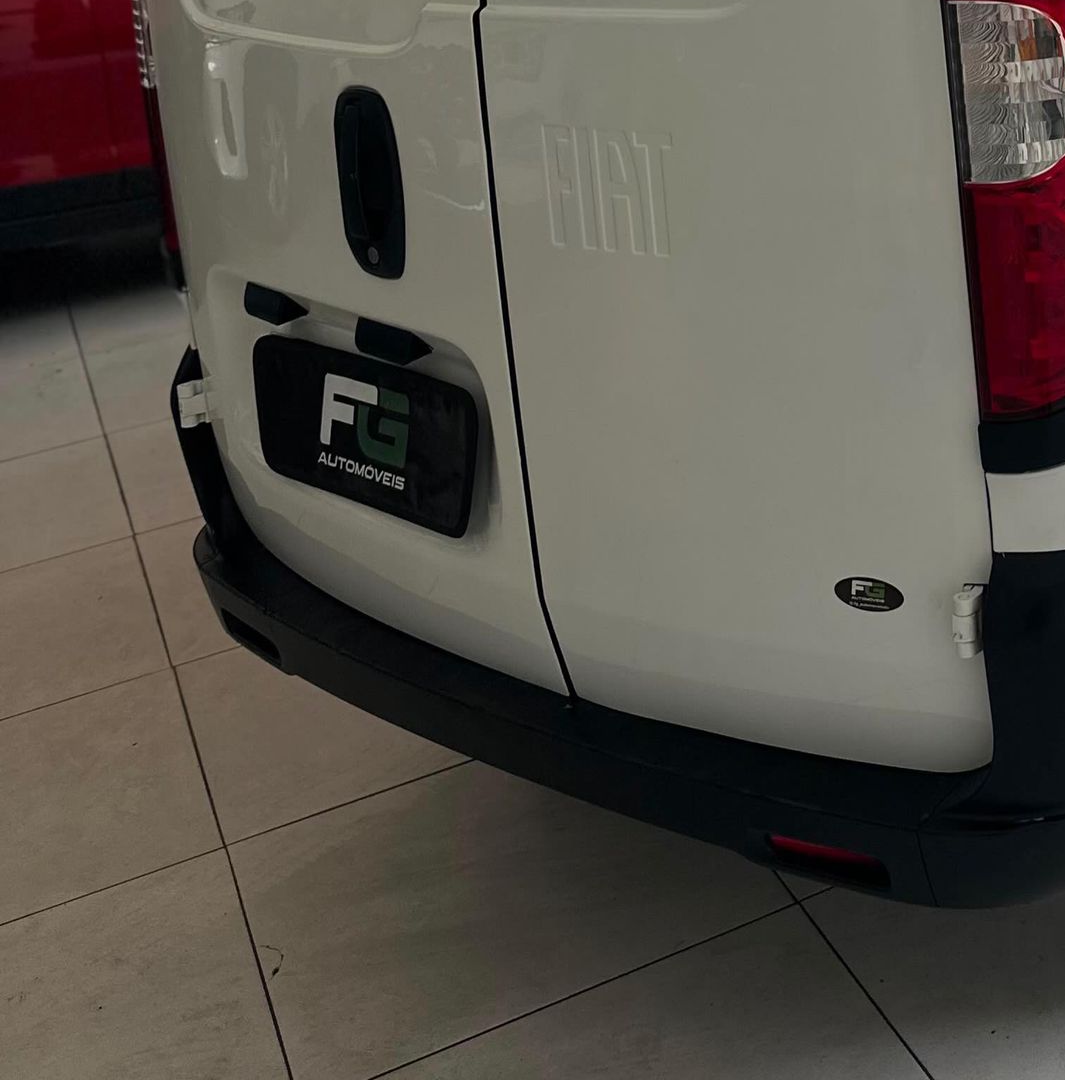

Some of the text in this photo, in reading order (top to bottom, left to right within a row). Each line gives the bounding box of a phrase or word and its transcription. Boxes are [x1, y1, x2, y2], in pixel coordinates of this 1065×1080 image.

[540, 124, 673, 257] FIAT
[320, 373, 410, 469] FG
[317, 451, 406, 491] AUTOMÓVEIS
[851, 580, 886, 600] FG
